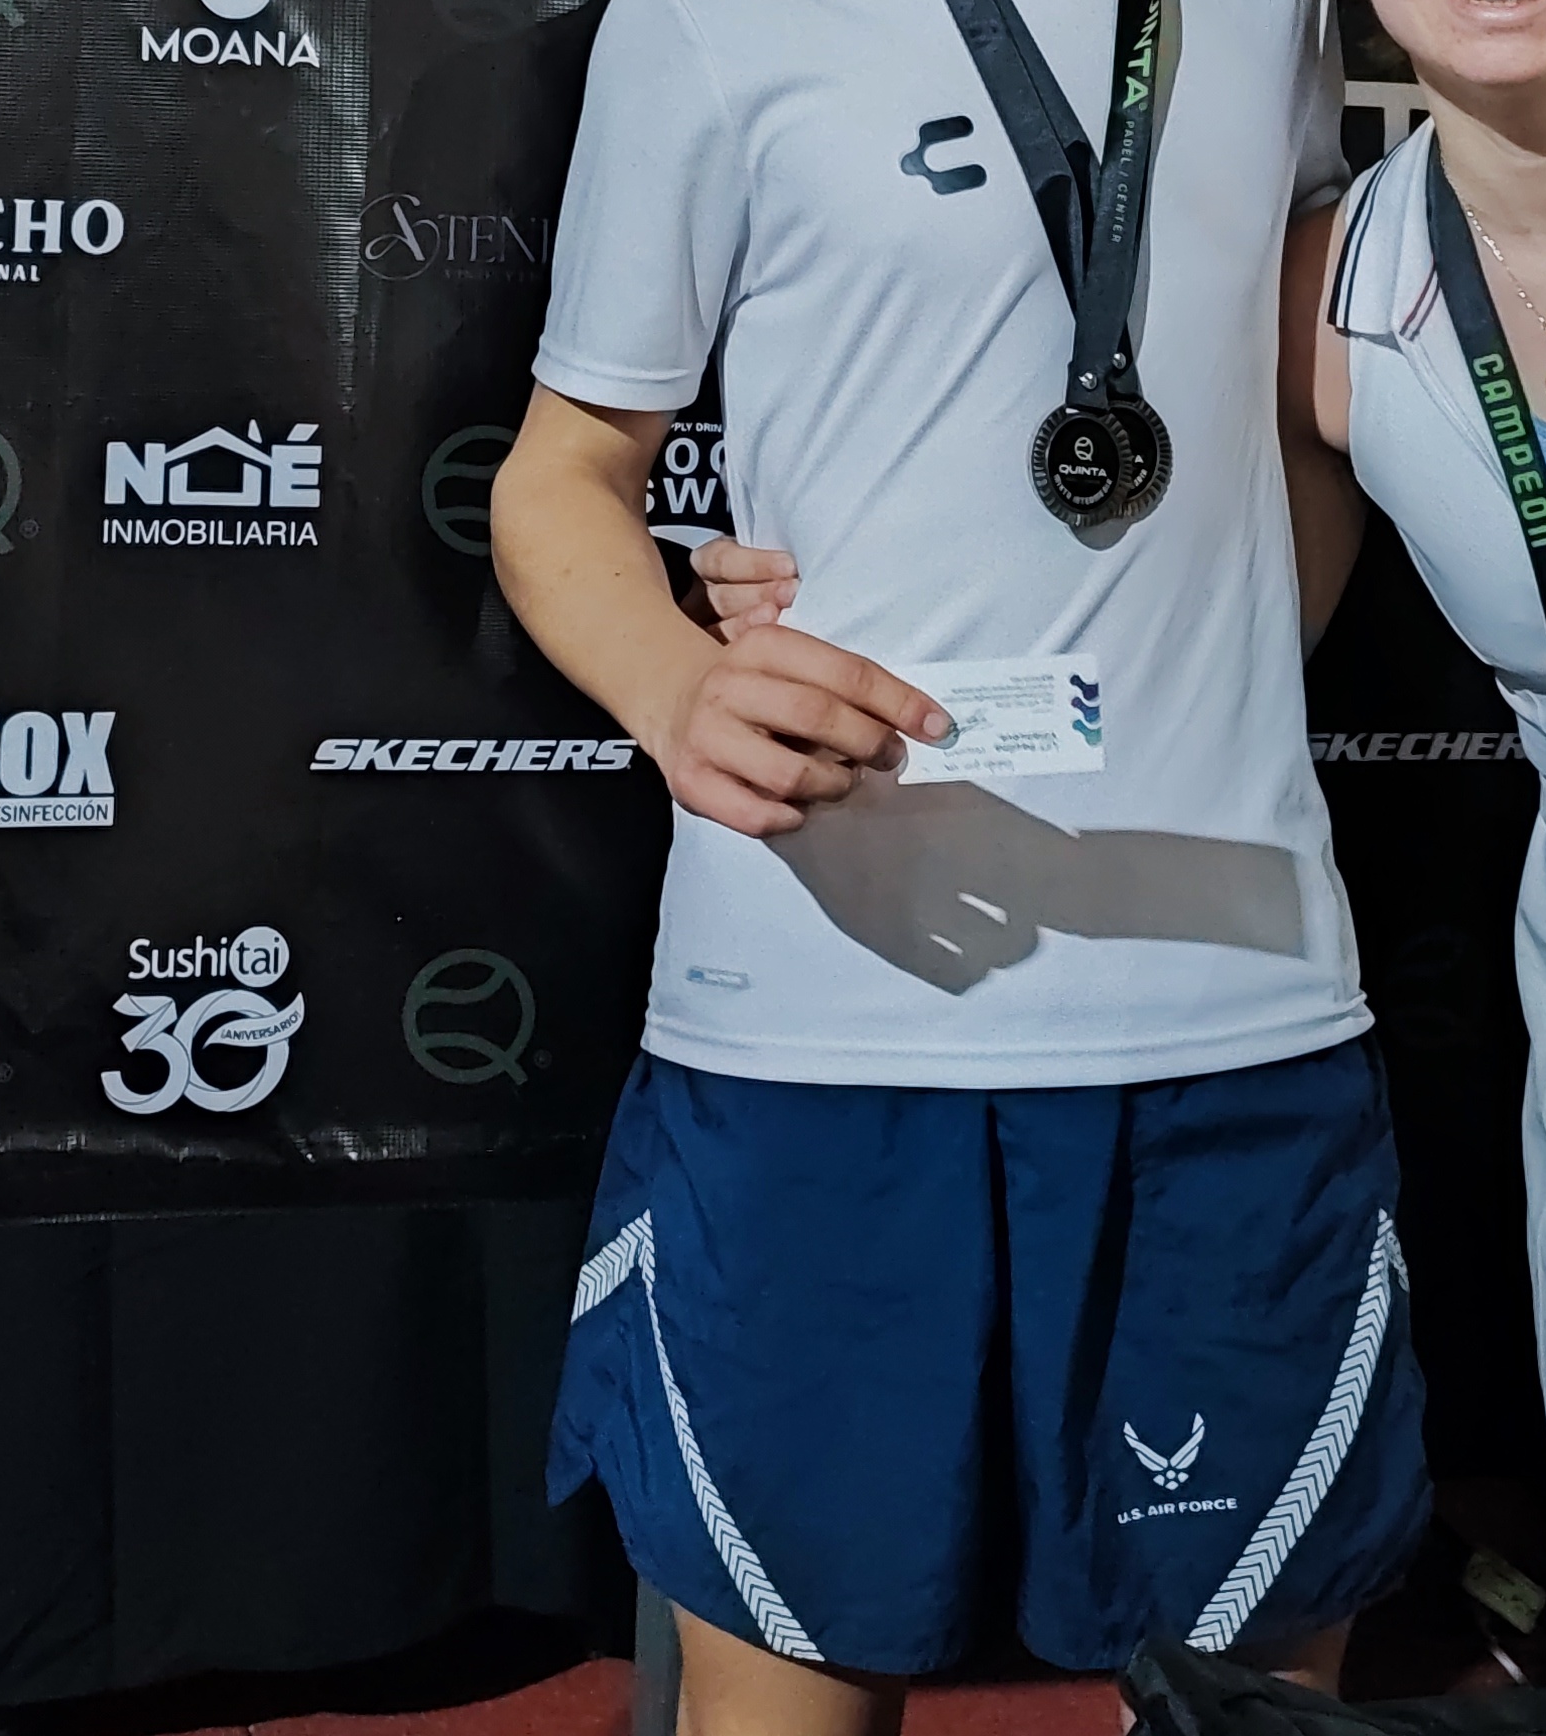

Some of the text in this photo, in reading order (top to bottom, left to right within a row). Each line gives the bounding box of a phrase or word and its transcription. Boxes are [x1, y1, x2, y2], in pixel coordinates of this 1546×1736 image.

[141, 26, 320, 69] MOANA
[1123, 120, 1135, 163] PADEL
[1111, 183, 1128, 244] CENTER
[696, 422, 722, 433] DRIN
[1058, 464, 1108, 477] QUINTA
[102, 518, 319, 549] INMOBILIARIA
[310, 739, 637, 772] SKECHERS
[1308, 732, 1527, 762] SKECHER
[1117, 1497, 1238, 1524] U.S. AIR FORCE
